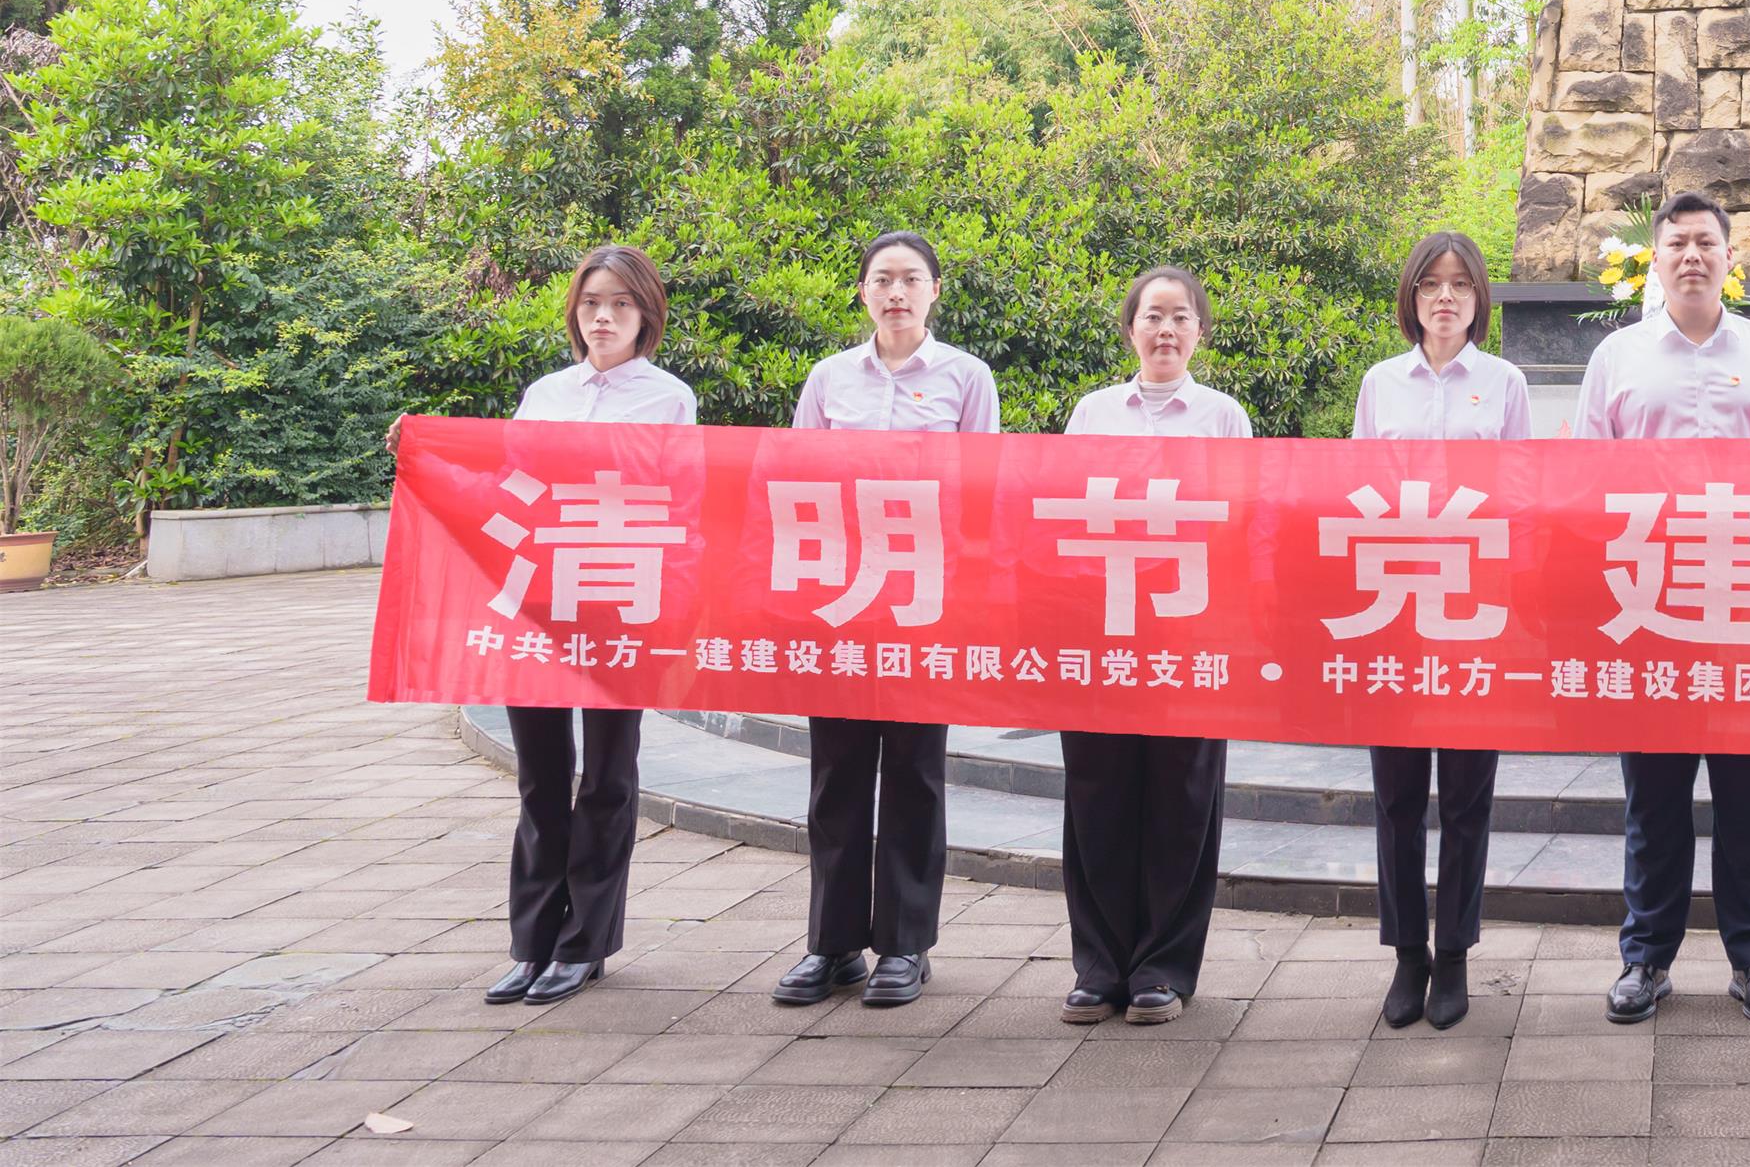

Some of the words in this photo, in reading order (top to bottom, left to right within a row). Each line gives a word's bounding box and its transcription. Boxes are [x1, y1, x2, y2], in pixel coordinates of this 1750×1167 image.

[465, 623, 1231, 691] 中共北方一建建设集团有限公司党支部
